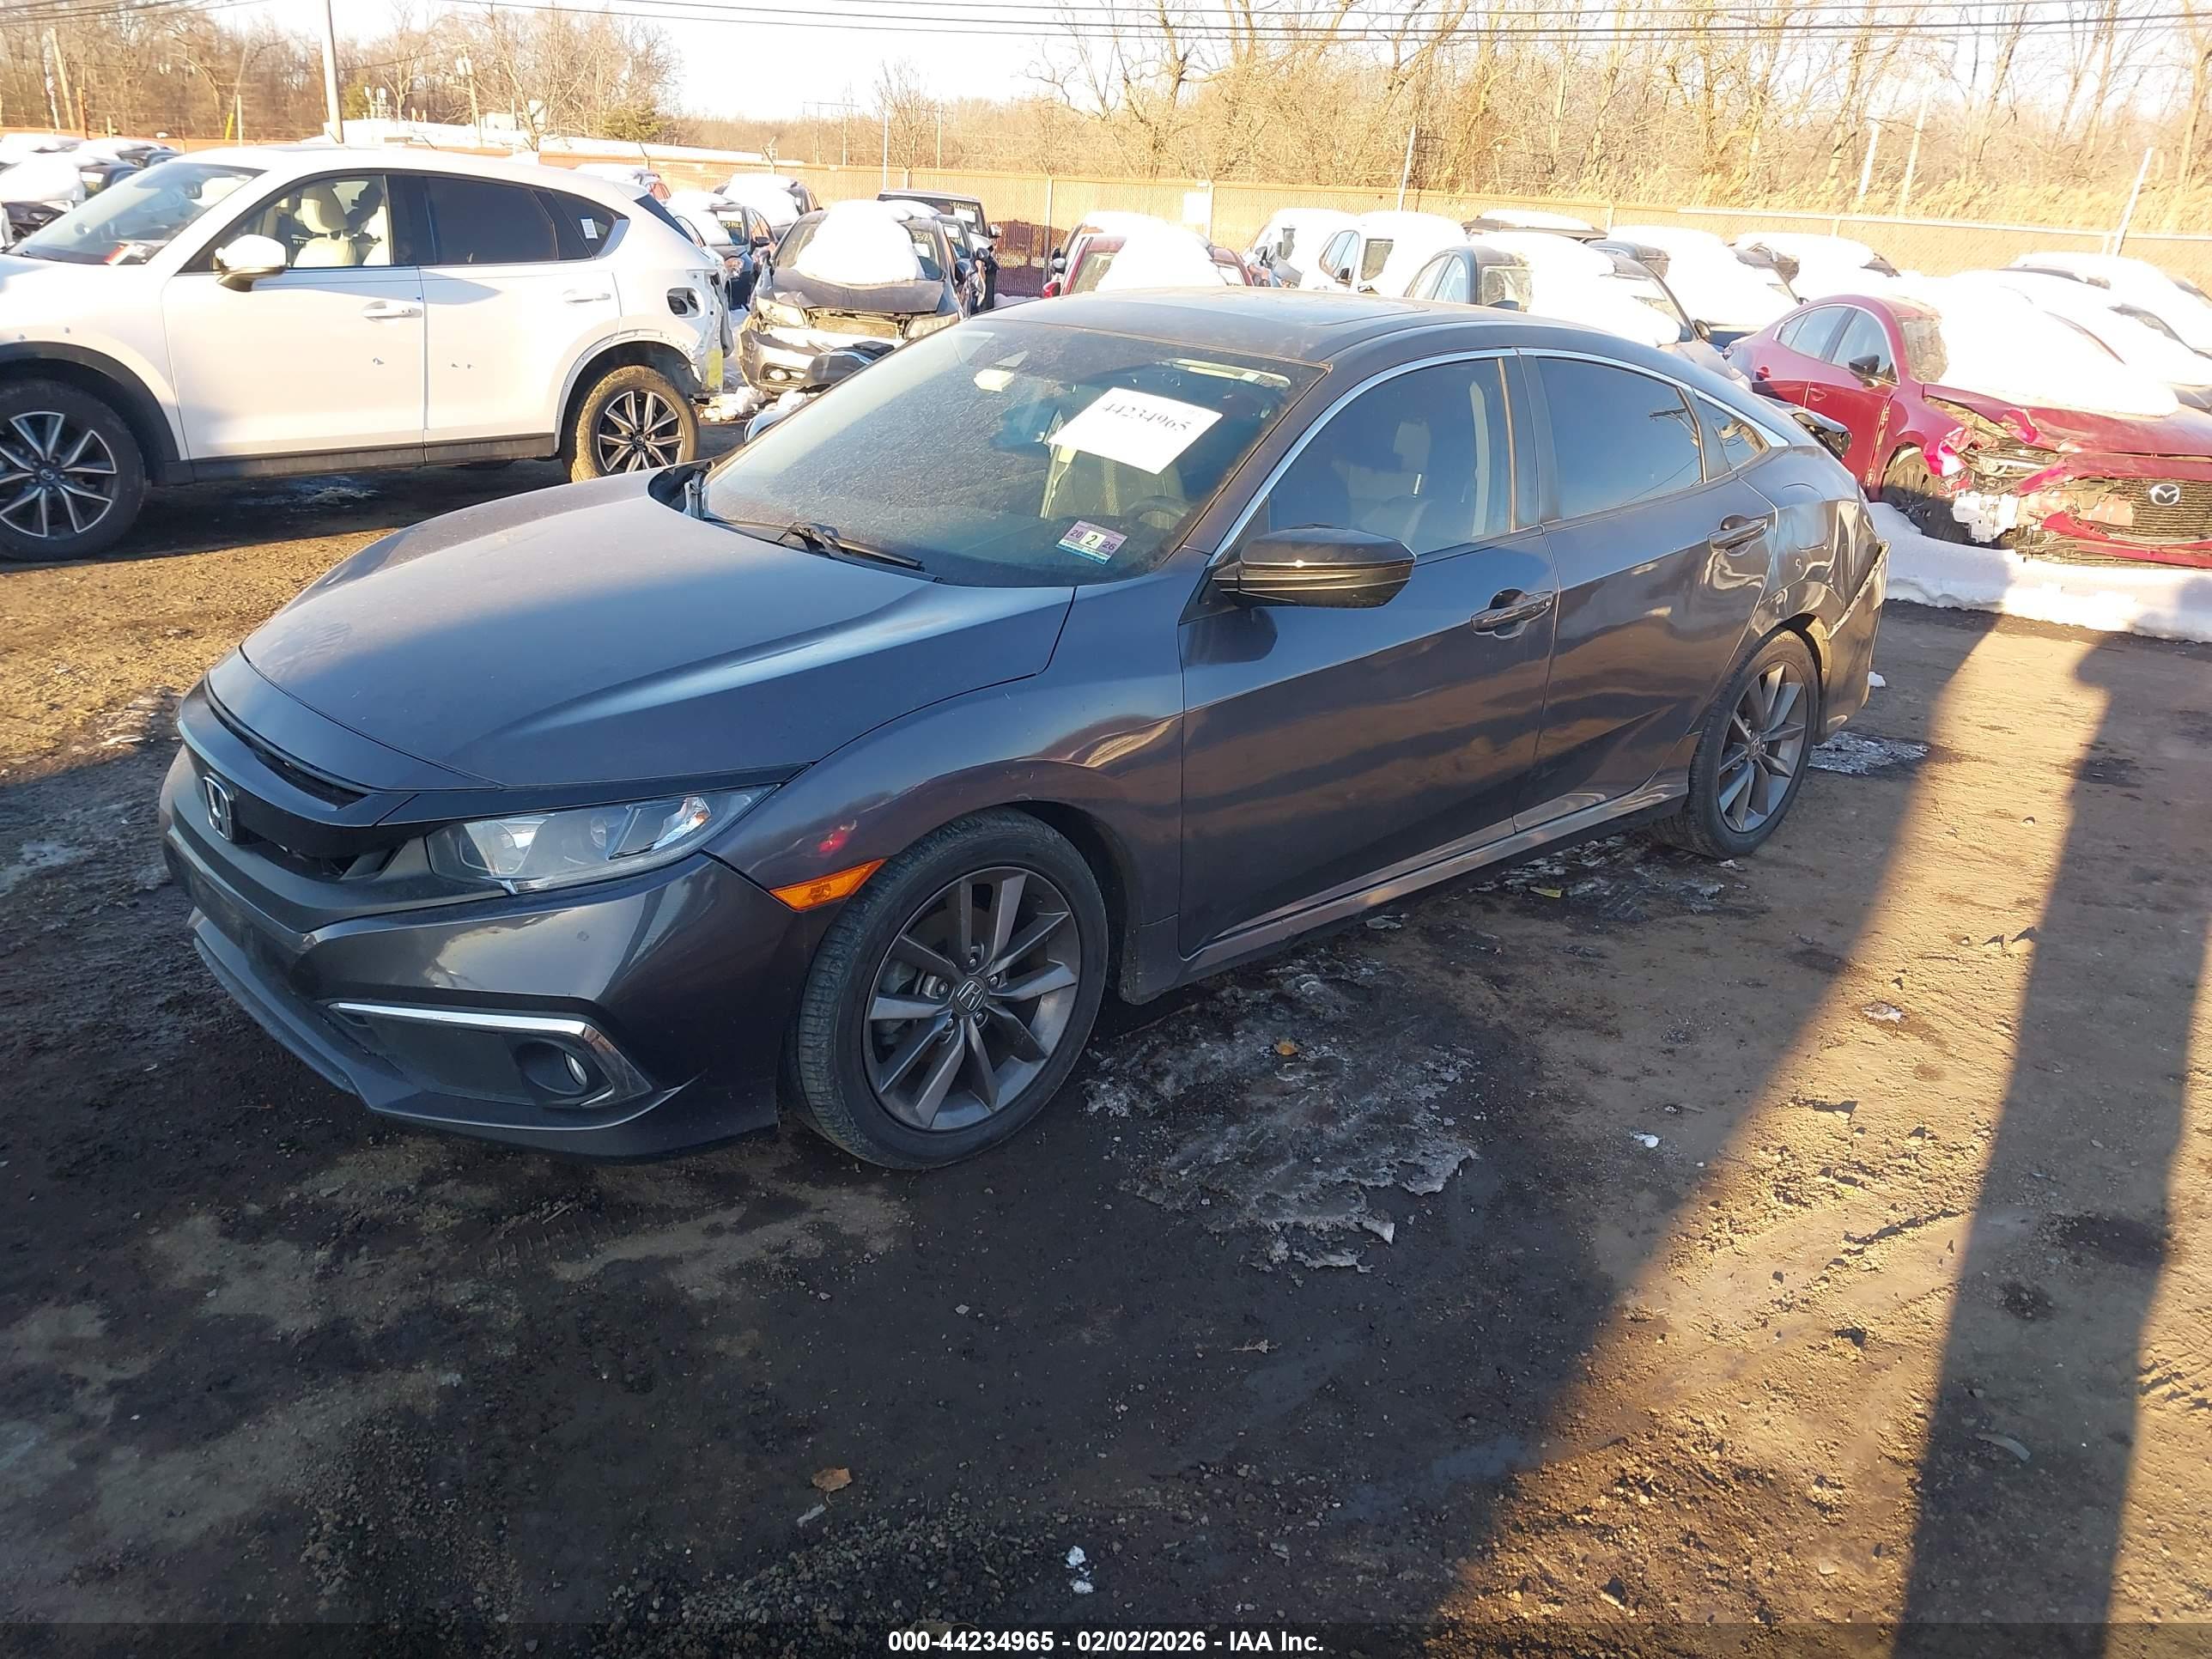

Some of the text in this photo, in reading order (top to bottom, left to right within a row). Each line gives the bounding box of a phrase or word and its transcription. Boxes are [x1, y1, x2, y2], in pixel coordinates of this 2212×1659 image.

[1102, 404, 1192, 431] 44234965
[1070, 530, 1084, 538] 20
[1085, 534, 1098, 545] 2
[1102, 541, 1117, 550] 26
